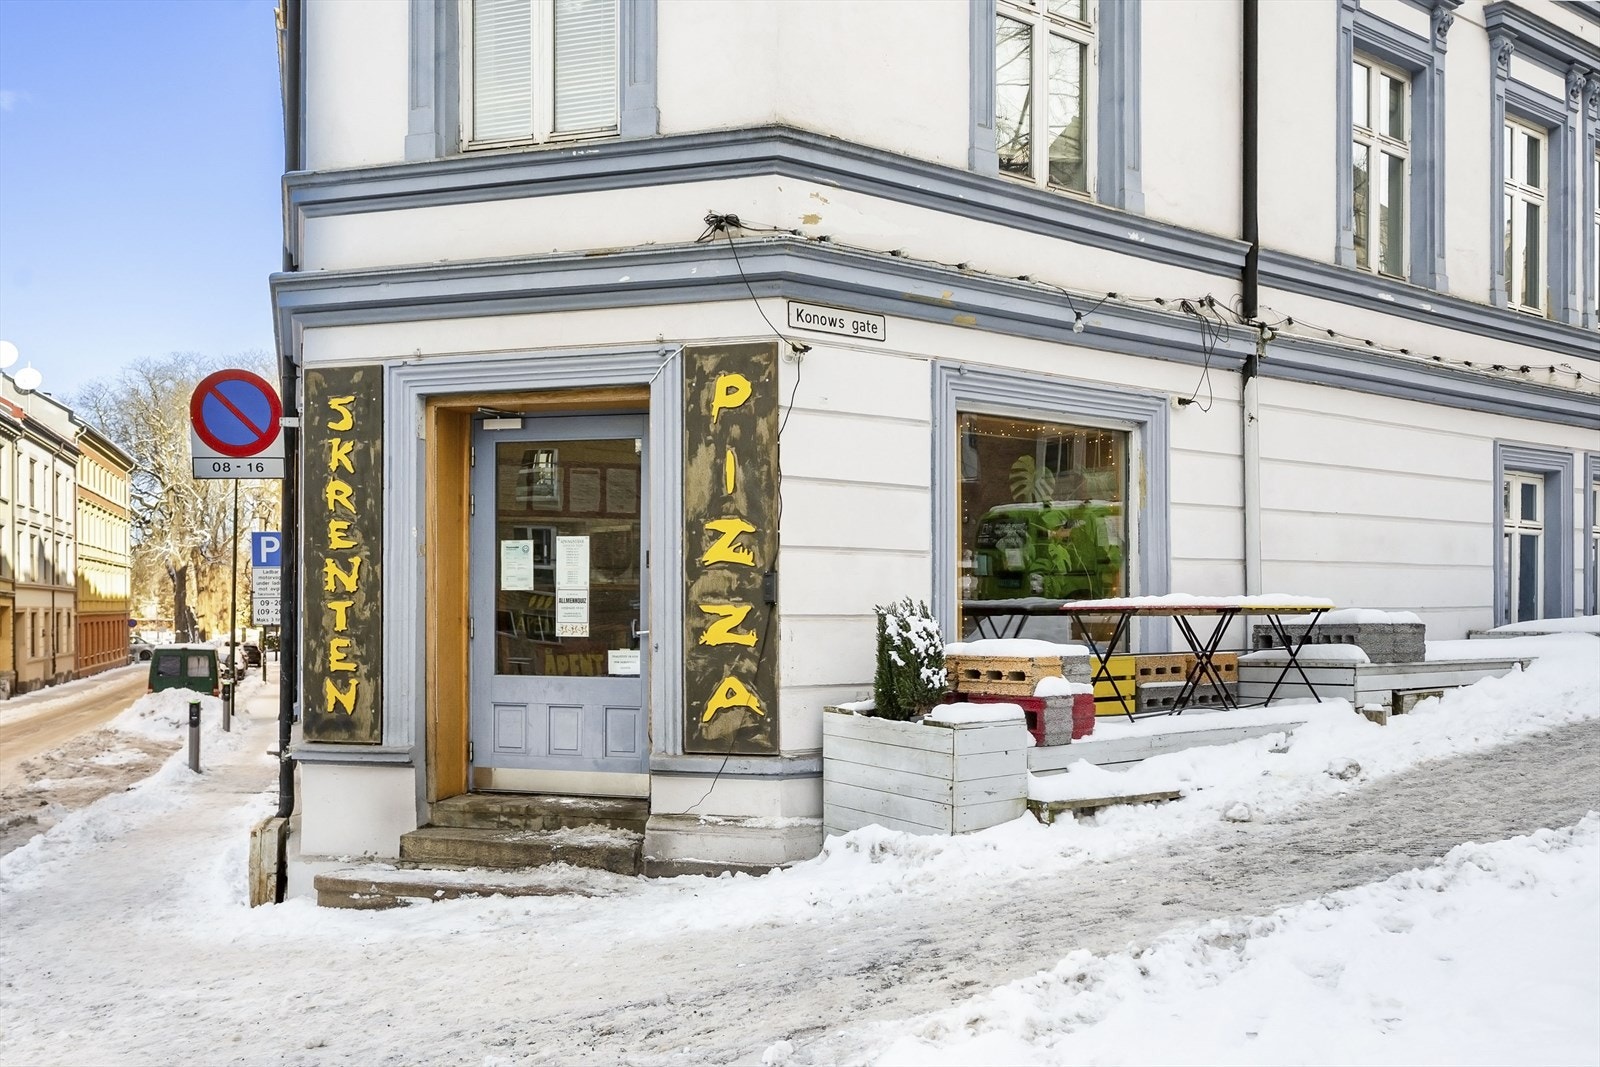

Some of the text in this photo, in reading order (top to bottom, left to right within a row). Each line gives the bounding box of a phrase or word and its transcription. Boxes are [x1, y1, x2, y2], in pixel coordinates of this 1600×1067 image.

[796, 308, 878, 334] Konows gate
[212, 462, 231, 473] 08
[247, 462, 264, 473] 16
[261, 536, 280, 563] P
[323, 395, 362, 716] SKRENTEN
[698, 373, 765, 723] PIZZA
